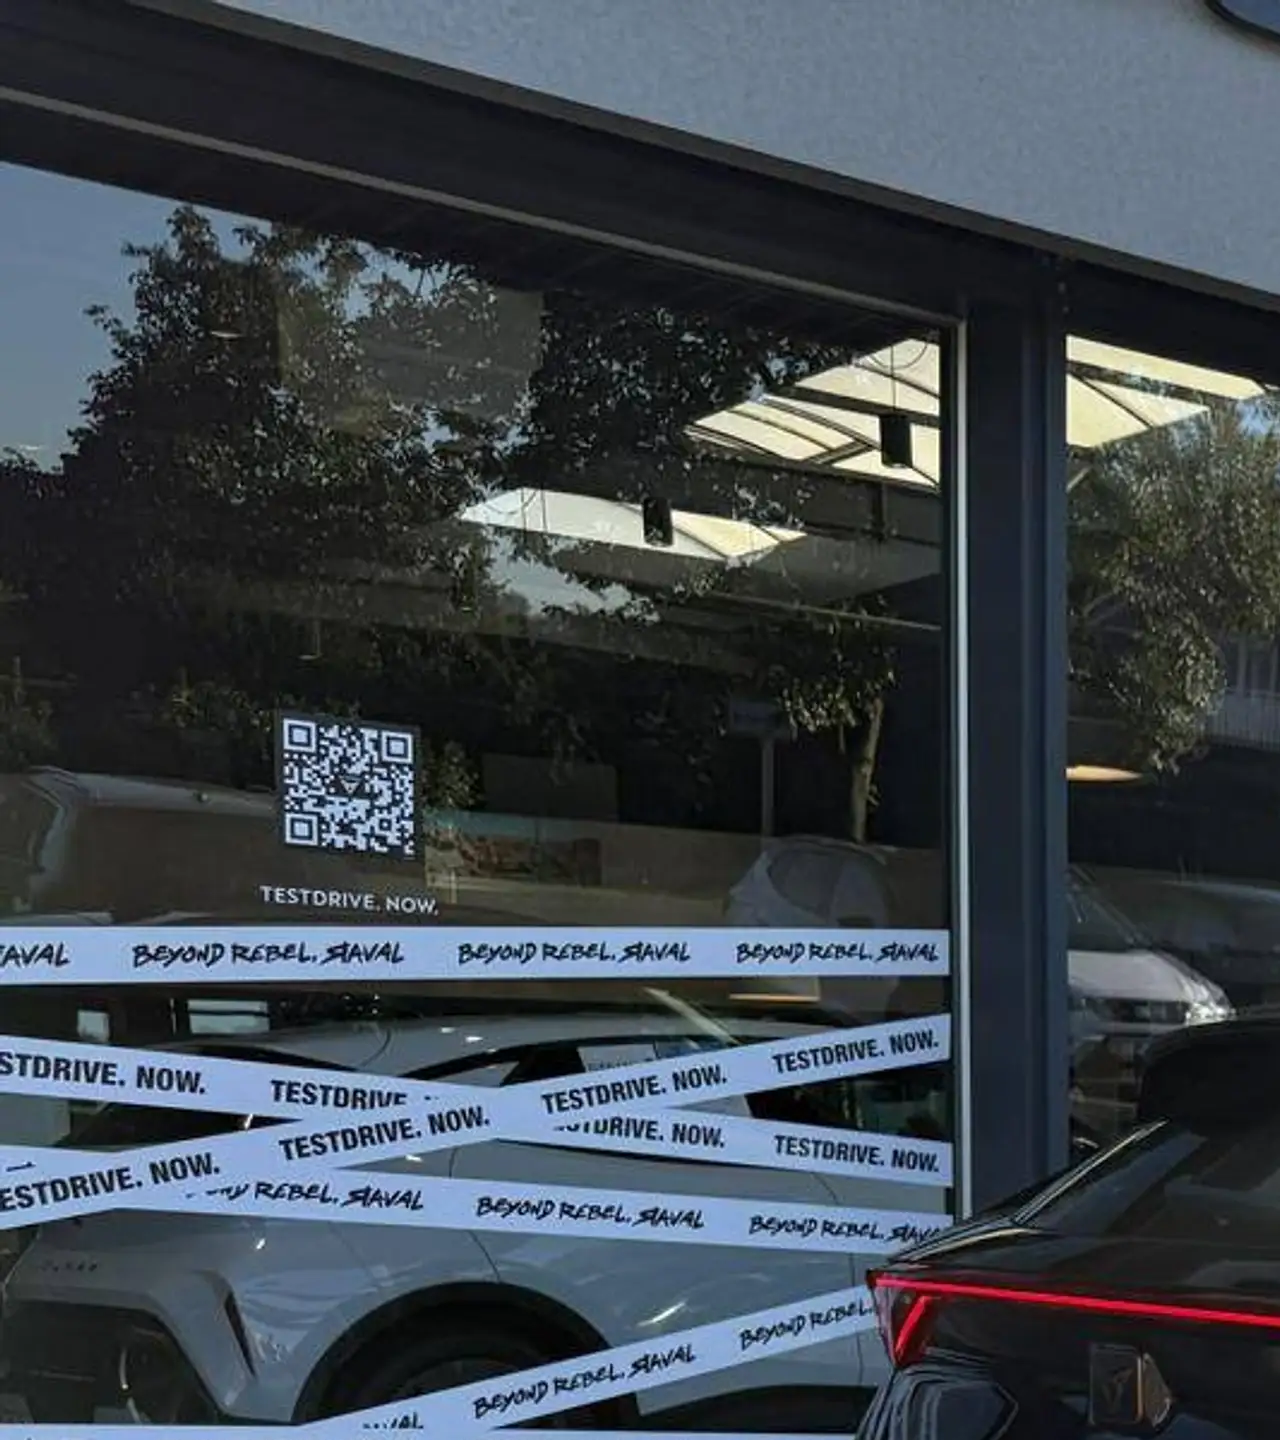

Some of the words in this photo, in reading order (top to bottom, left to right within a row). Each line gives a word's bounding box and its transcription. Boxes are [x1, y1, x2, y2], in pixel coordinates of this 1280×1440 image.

[260, 885, 381, 912] TESTDRIVE.
[386, 896, 439, 916] NOW.
[0, 942, 71, 968] AVAL
[132, 943, 225, 968] BEYOND
[230, 943, 318, 963] REBEL.
[458, 942, 537, 964] BEYOND
[541, 943, 617, 961] REBEL.
[736, 942, 805, 964] BEYOND
[807, 943, 873, 961] REBEL.
[136, 1064, 206, 1095] NOW.
[671, 1122, 725, 1149] NOW.
[774, 1134, 885, 1167] TESTDRIVE.
[890, 1148, 940, 1173] NOW.
[149, 1152, 221, 1185] NOW.
[278, 1117, 422, 1161] TESTDRIVE.
[427, 1105, 491, 1135] NOW.
[541, 1075, 667, 1115] TESTDRIVE.
[671, 1063, 728, 1093] NOW.
[772, 1039, 885, 1075] TESTDRIVE.
[888, 1028, 940, 1056] NOW.
[254, 1181, 340, 1205] REBEL.
[476, 1196, 556, 1220] BEYOND
[558, 1201, 632, 1224] REBEL.
[749, 1214, 818, 1237] BEYOND
[820, 1219, 885, 1241] REBEL.
[473, 1381, 549, 1418] BEYOND
[552, 1362, 626, 1398] REBEL.
[739, 1313, 808, 1351] BEYOND
[809, 1297, 873, 1330] REBEL.
